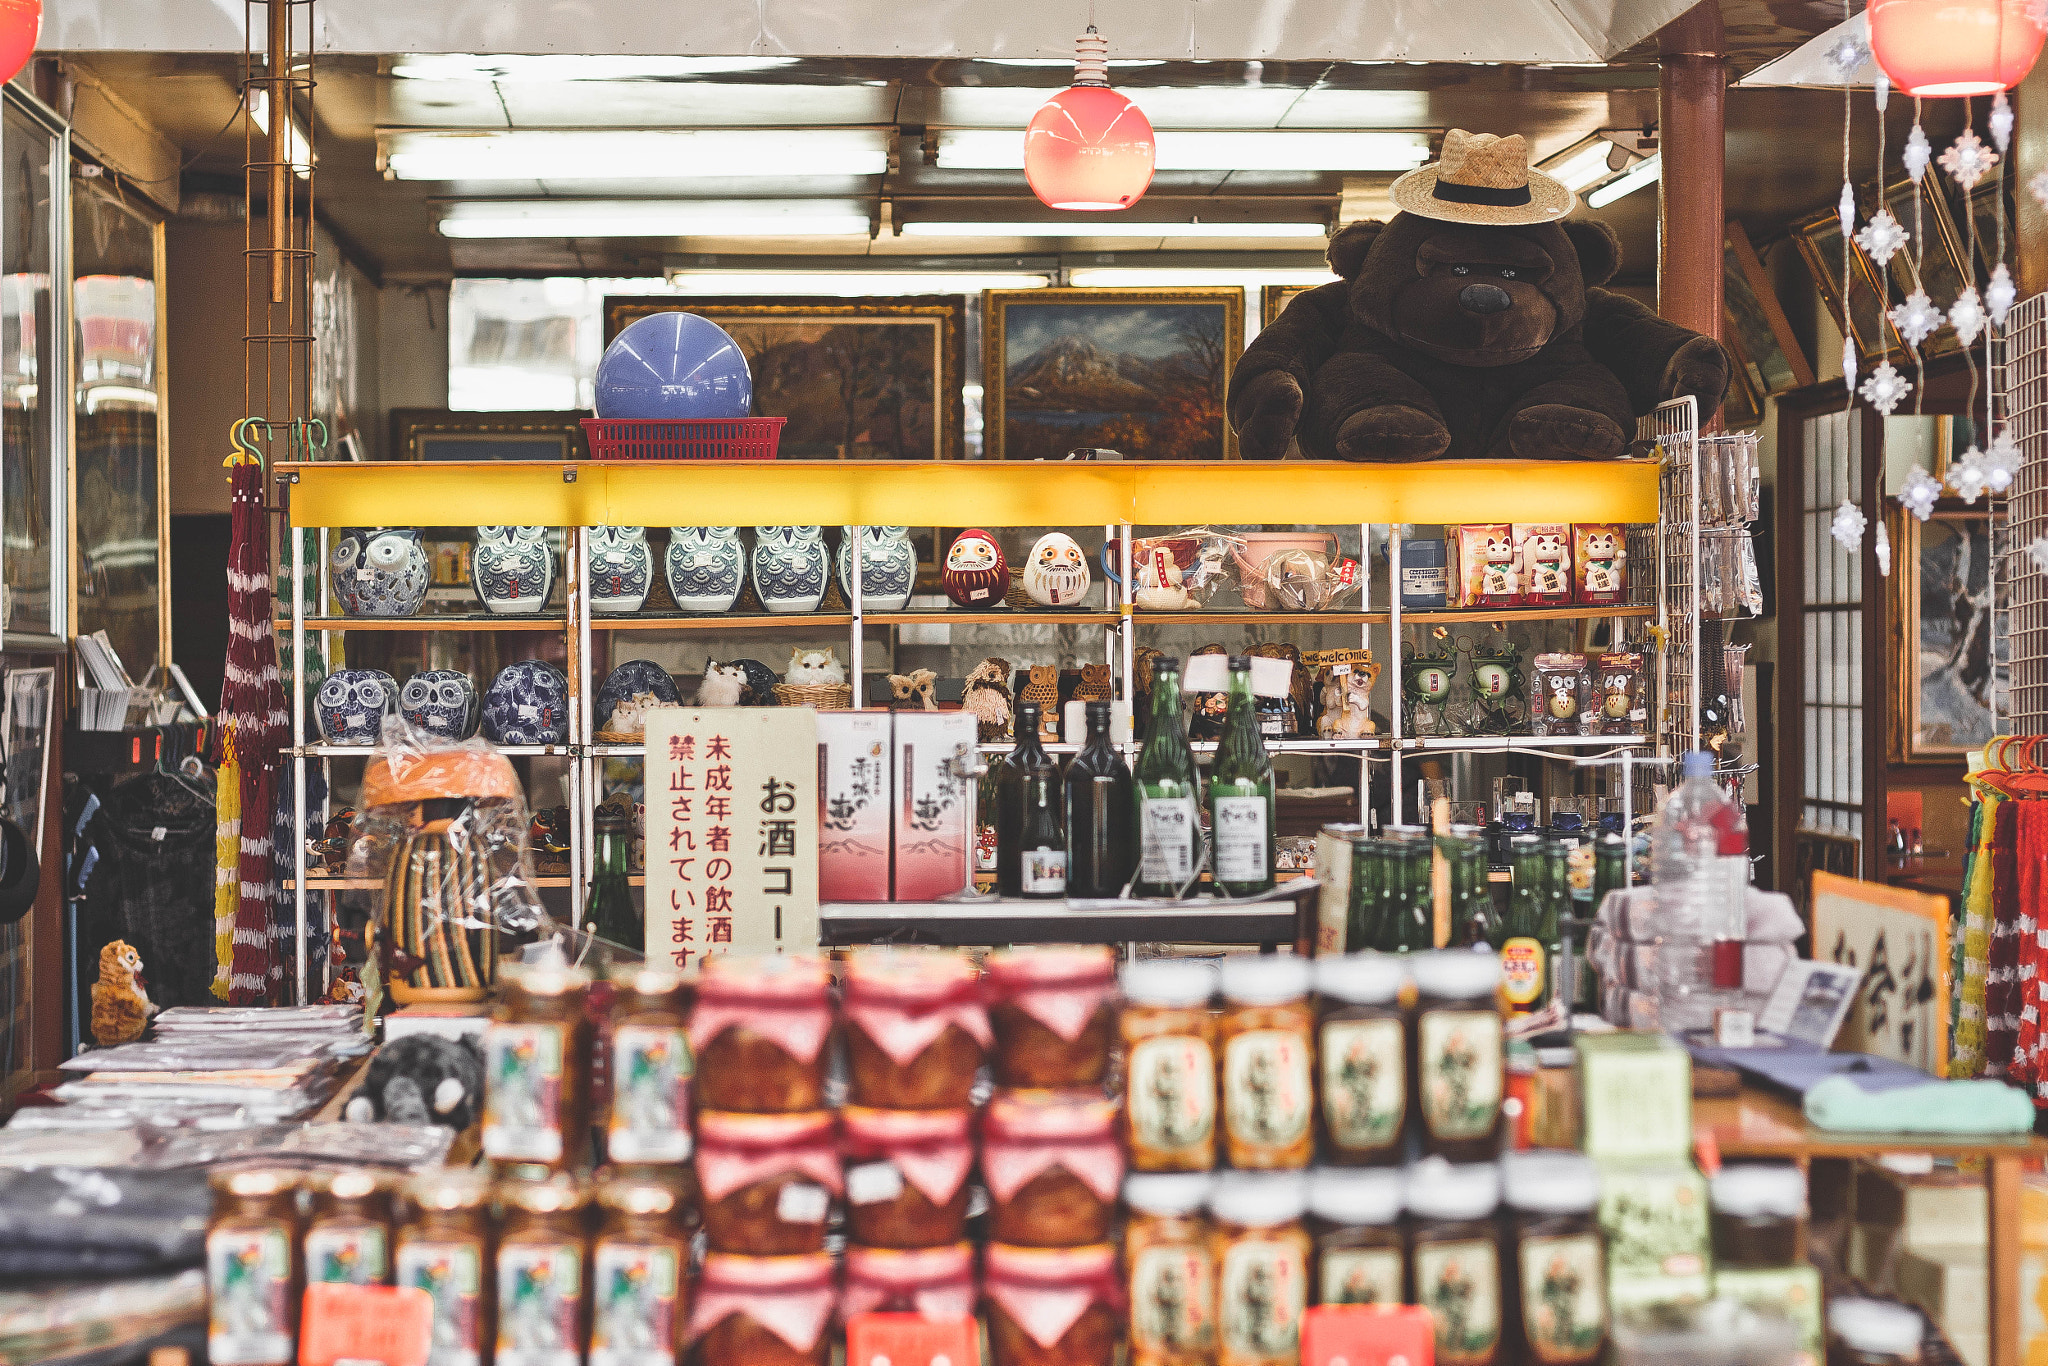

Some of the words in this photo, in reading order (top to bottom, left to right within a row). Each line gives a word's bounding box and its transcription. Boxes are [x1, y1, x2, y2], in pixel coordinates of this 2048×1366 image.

[1320, 651, 1368, 663] welcome
[669, 735, 696, 970] 禁止されています
[705, 735, 733, 954] 未成年者の飲酒
[757, 776, 797, 954] お酒コー
